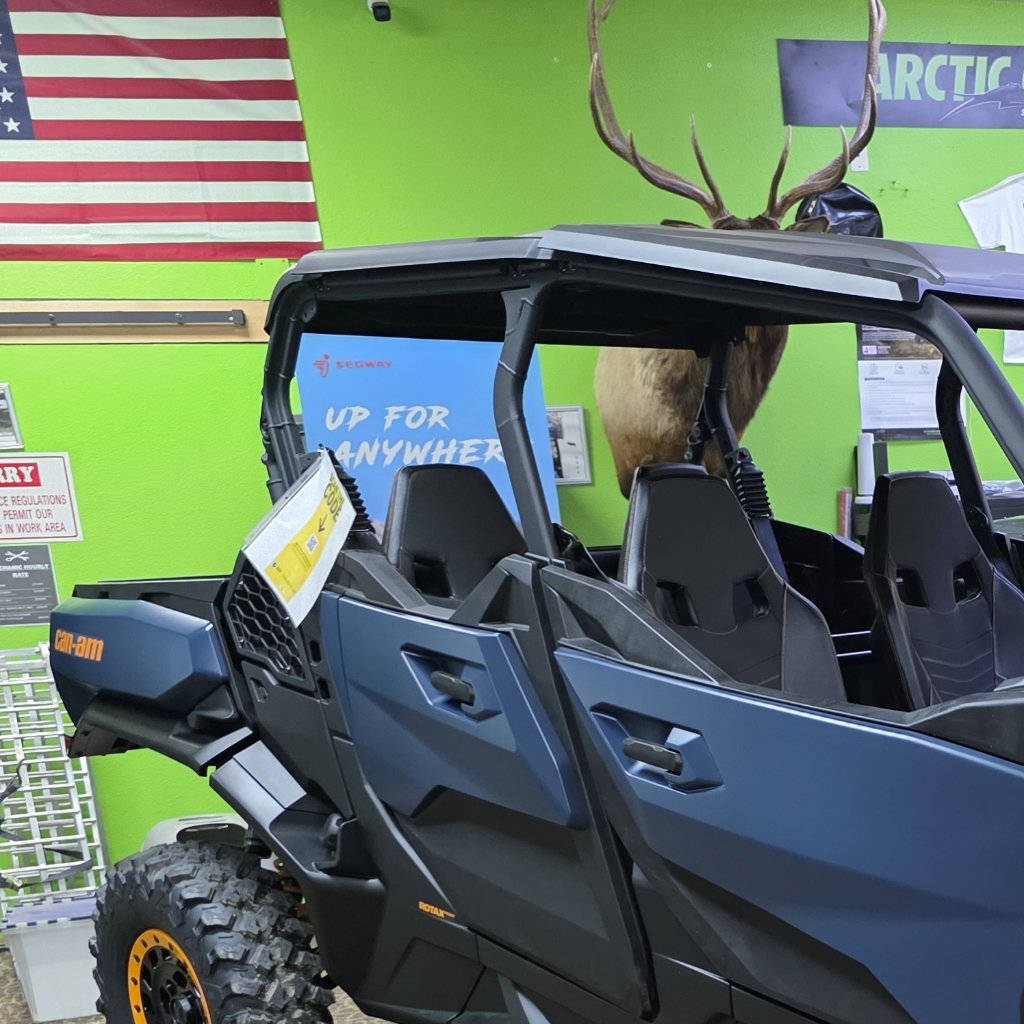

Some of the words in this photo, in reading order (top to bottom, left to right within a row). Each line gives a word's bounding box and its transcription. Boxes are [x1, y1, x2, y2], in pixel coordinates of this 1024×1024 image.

[875, 53, 1011, 102] ARCTIC
[336, 360, 393, 368] SEGWAY
[325, 405, 371, 432] UP
[383, 405, 450, 432] FOR
[335, 437, 507, 470] ANYWHER
[0, 466, 34, 483] RY
[11, 494, 67, 506] REGULATIONS
[3, 509, 32, 520] PERMIT
[35, 508, 53, 519] OUR
[5, 523, 14, 534] IN
[16, 522, 42, 534] WORK
[45, 521, 66, 532] AREA
[54, 629, 104, 662] can-am
